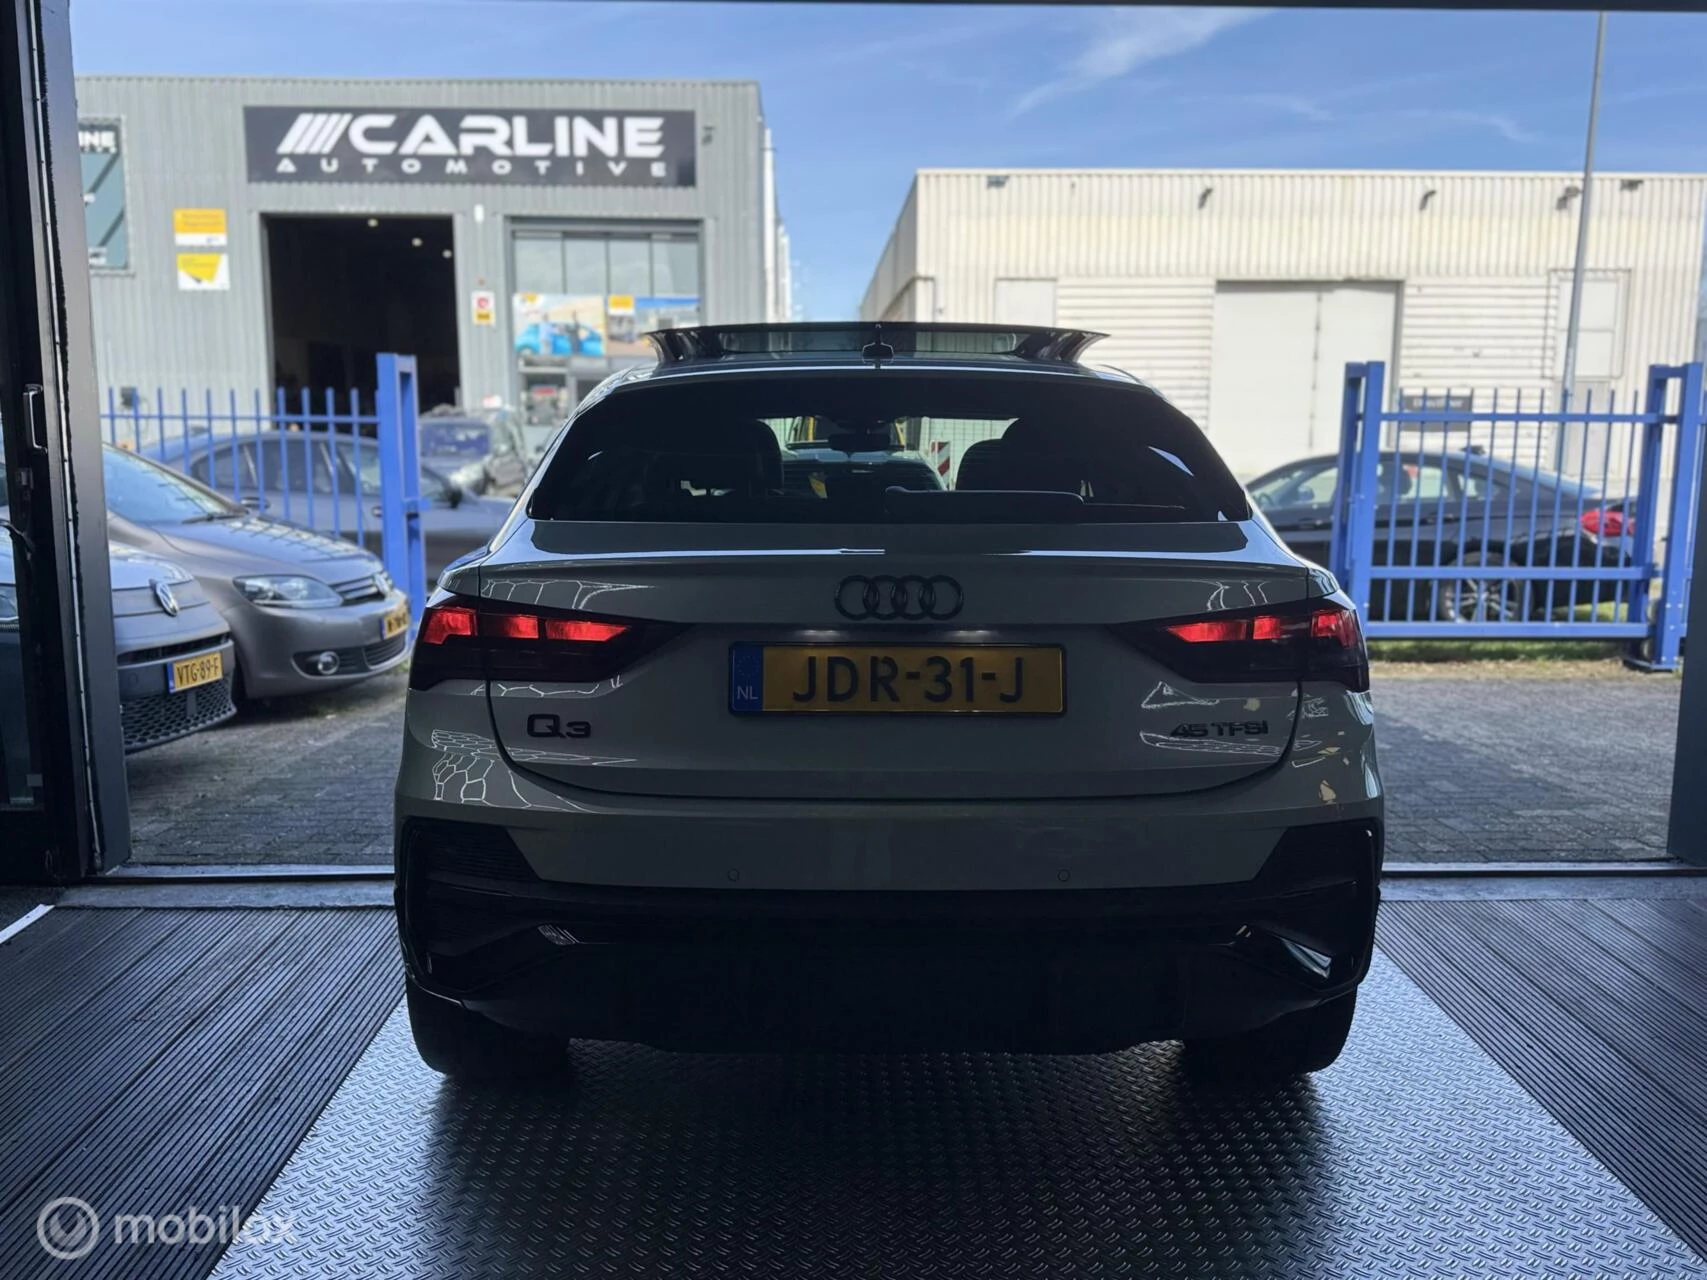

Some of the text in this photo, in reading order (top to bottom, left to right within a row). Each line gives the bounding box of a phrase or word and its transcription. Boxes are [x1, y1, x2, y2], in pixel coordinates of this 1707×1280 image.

[348, 113, 665, 158] CARLINE
[276, 157, 666, 178] AUTOMOTIVE
[793, 655, 1024, 703] JDR-31-J
[736, 686, 759, 700] NL
[527, 714, 592, 738] Q3
[1170, 720, 1269, 737] 45 TFSI
